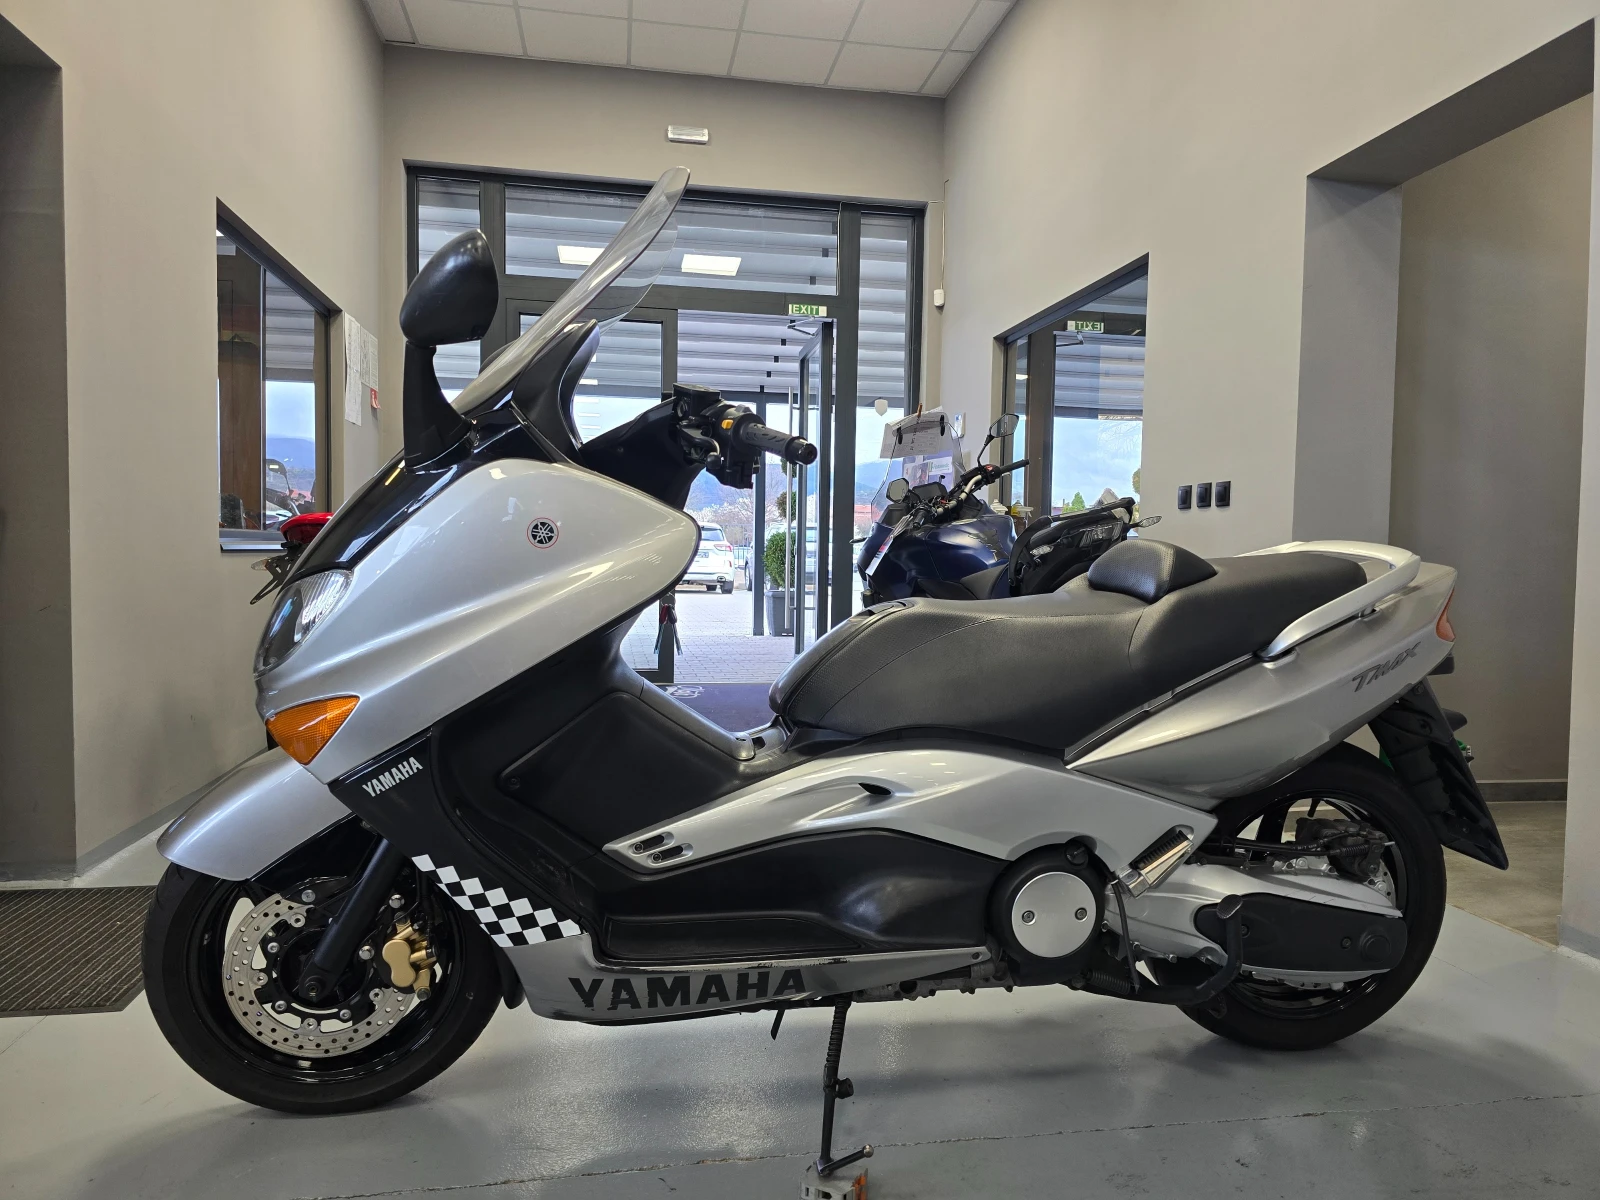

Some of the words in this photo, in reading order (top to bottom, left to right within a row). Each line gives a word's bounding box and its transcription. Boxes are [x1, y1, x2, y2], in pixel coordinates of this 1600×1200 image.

[792, 304, 818, 315] EXIT
[362, 756, 423, 797] YAMAHA
[568, 968, 806, 1011] YAMAHA
